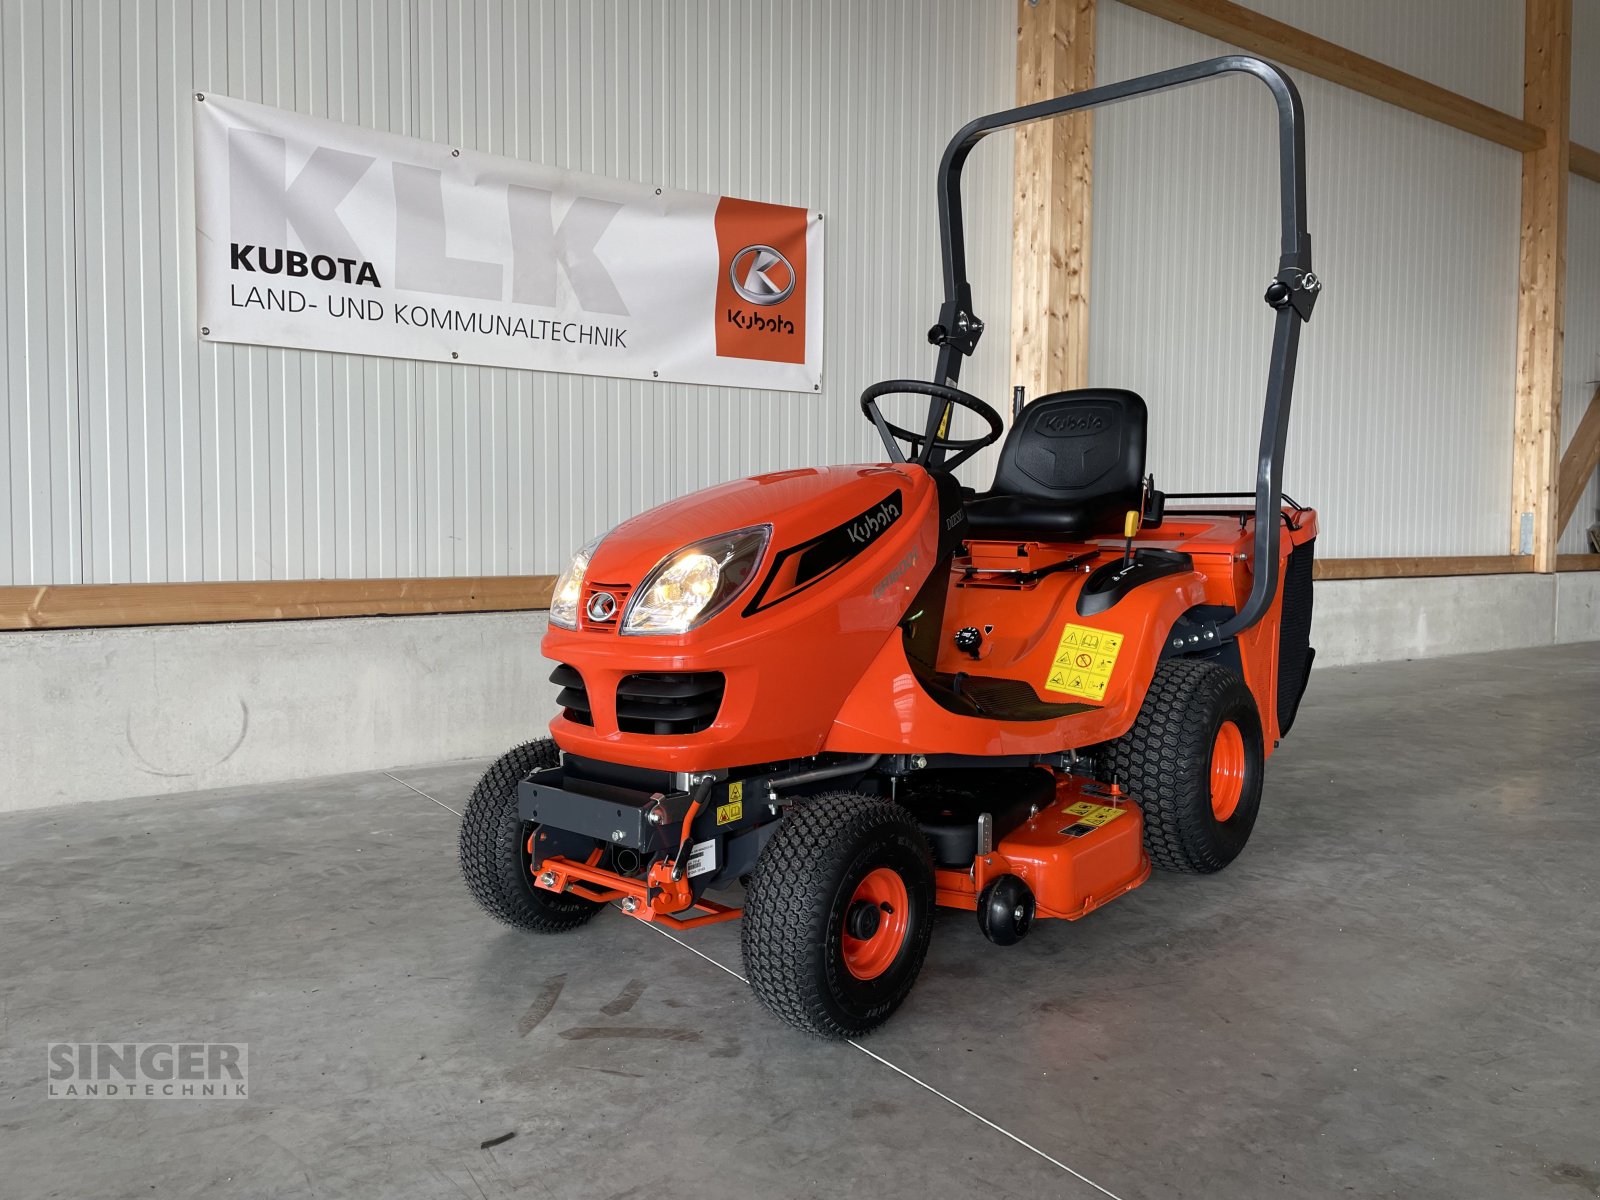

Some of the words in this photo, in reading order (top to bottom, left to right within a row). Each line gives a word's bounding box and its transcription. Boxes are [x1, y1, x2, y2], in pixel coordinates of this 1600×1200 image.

[227, 127, 632, 317] KLK
[230, 242, 382, 289] KUBOTA
[230, 283, 318, 313] LAND-
[327, 294, 384, 322] UND
[394, 302, 628, 349] KOMMUNALTECHNIK
[727, 308, 795, 335] Kubota
[1045, 412, 1102, 432] Kubota
[847, 503, 900, 543] Kubota
